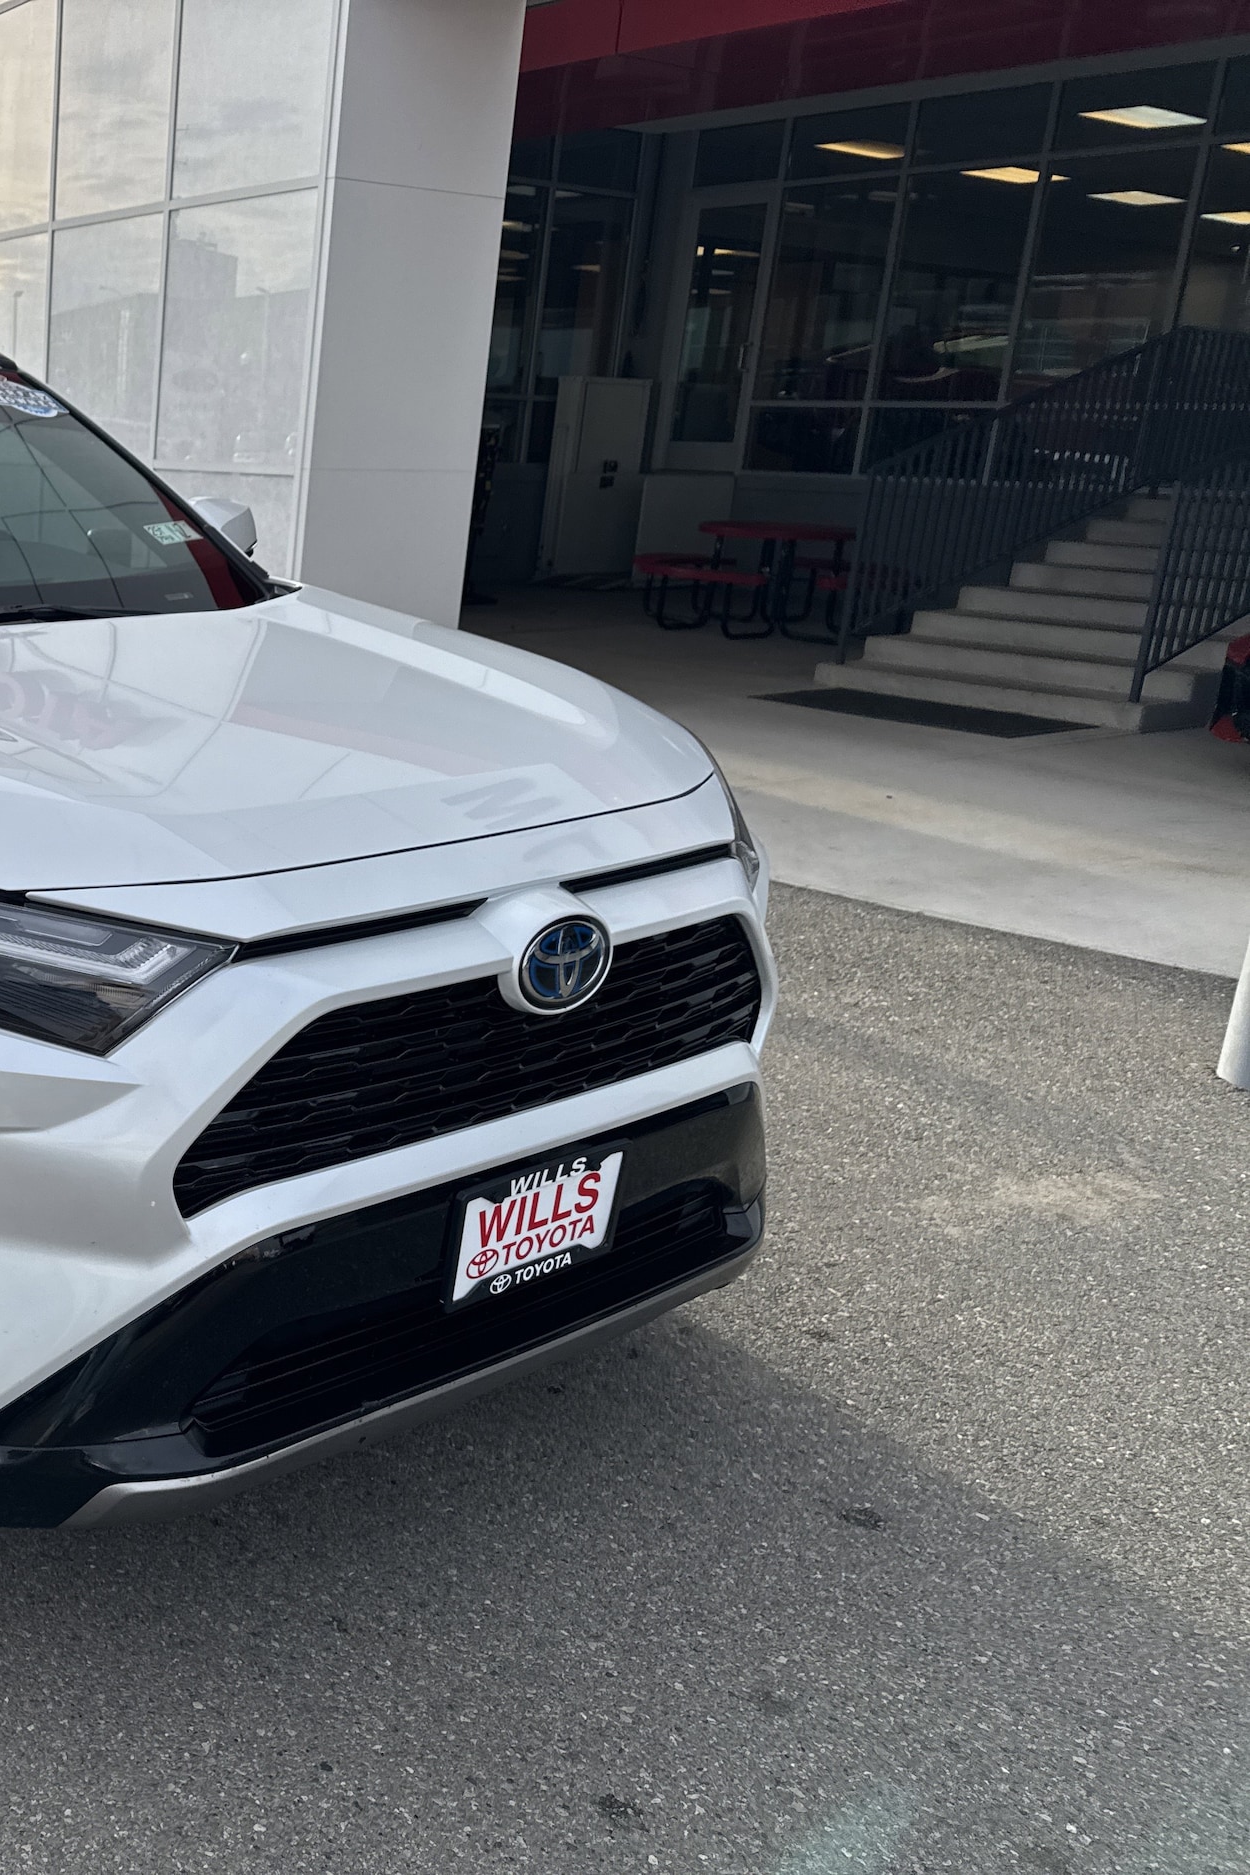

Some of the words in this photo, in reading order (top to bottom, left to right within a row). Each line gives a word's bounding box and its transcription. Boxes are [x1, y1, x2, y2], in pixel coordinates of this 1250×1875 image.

[510, 1156, 588, 1194] WILLS
[479, 1172, 601, 1249] WILLS
[502, 1214, 595, 1266] TOYOTA
[514, 1251, 572, 1285] TOYOTA
